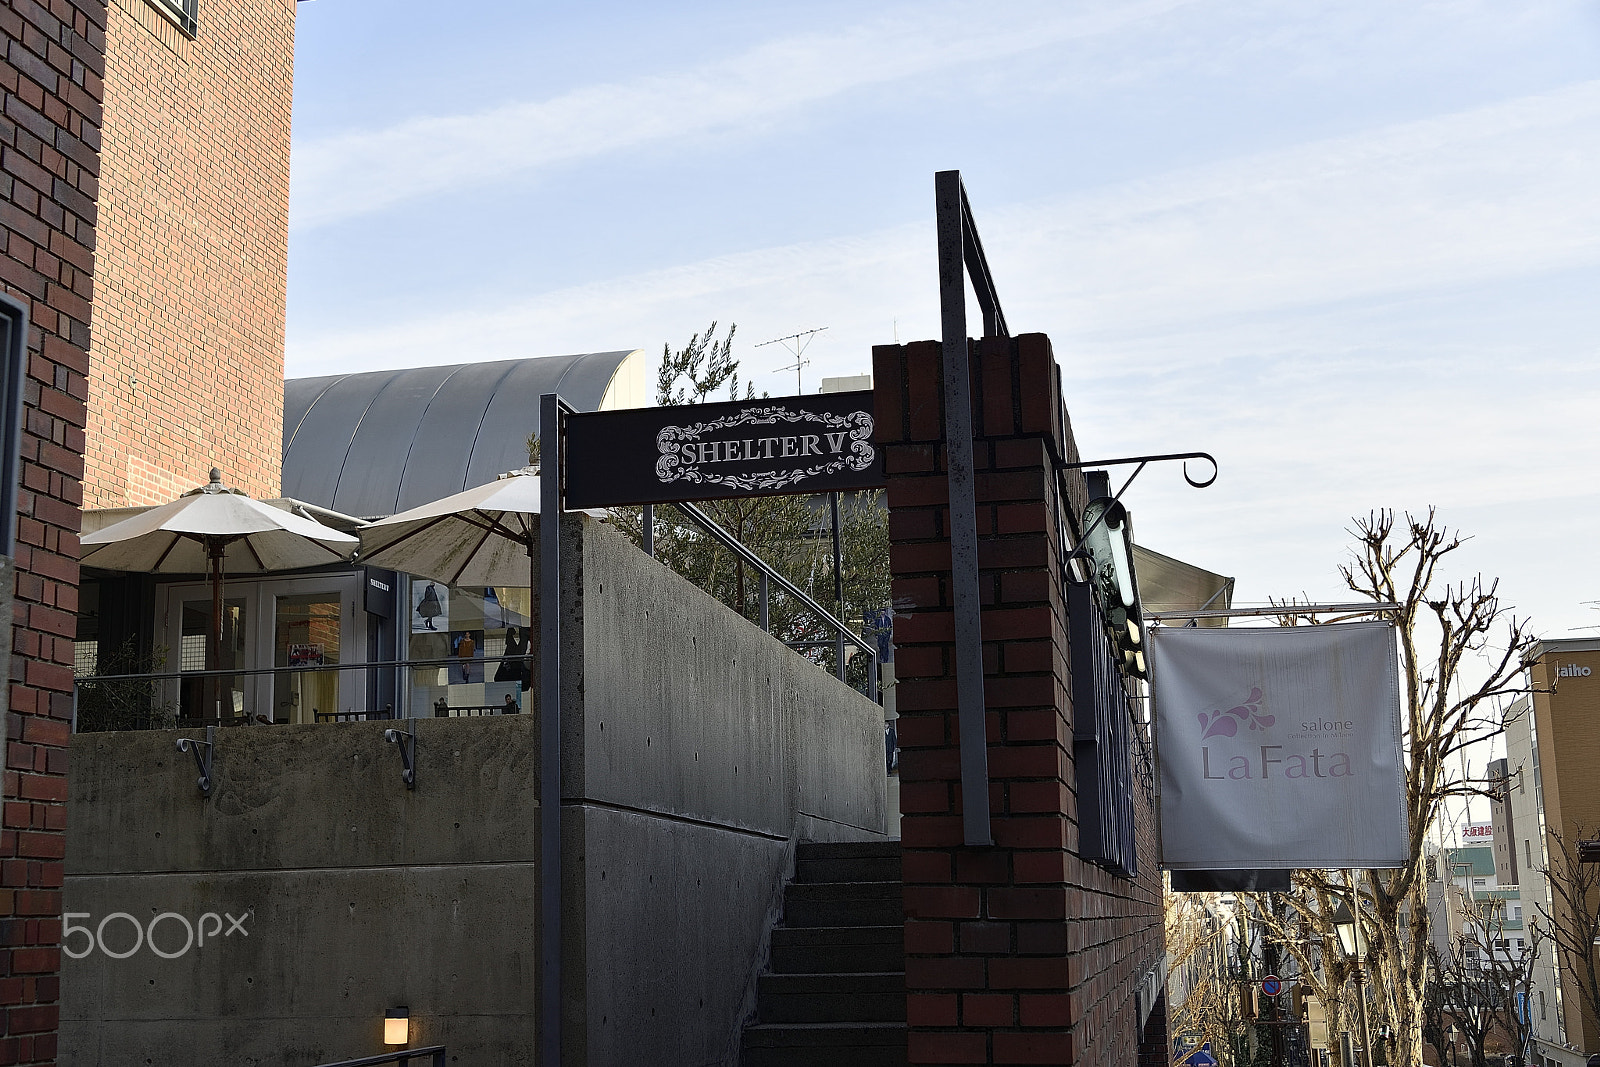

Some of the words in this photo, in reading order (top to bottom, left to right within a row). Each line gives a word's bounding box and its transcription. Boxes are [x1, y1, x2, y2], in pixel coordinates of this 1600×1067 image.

[1301, 717, 1353, 731] salone
[1202, 746, 1253, 780] La
[1260, 745, 1355, 779] Fata
